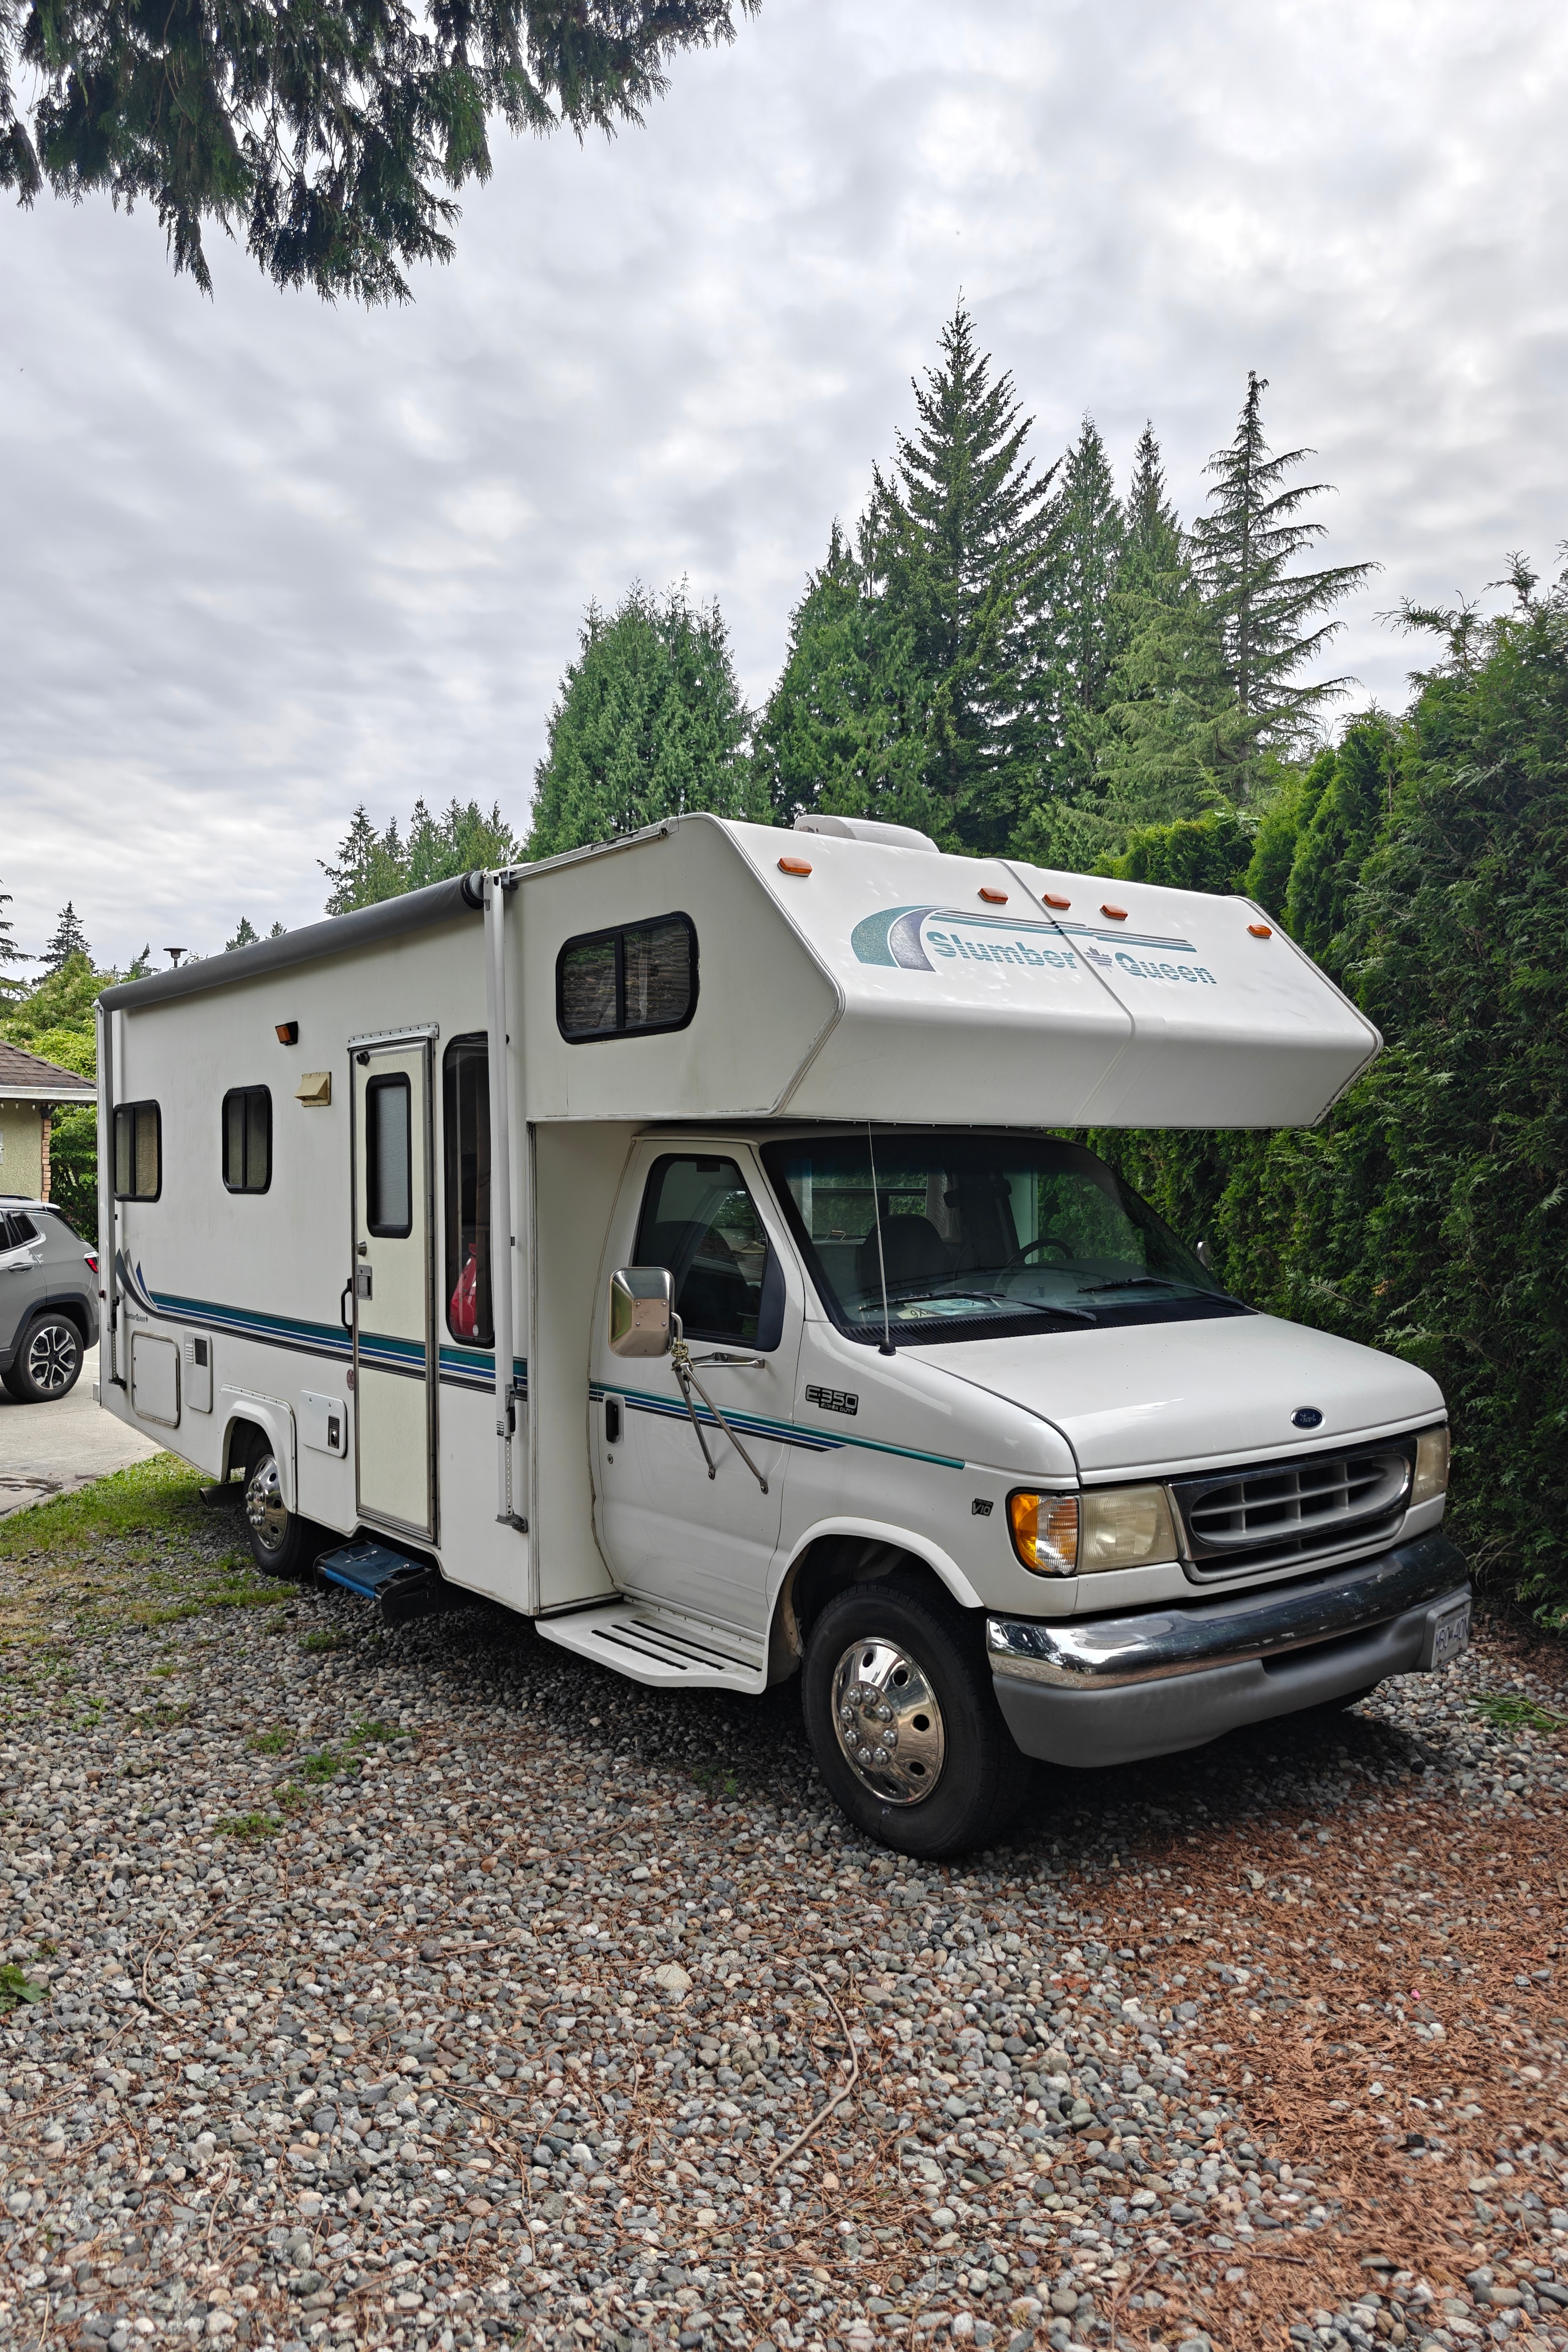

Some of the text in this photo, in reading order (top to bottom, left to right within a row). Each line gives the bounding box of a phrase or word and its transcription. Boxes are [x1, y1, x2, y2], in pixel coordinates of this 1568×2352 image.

[926, 931, 1217, 984] Slumber Queen
[820, 1403, 839, 1411] SUPER
[973, 1502, 990, 1515] V10
